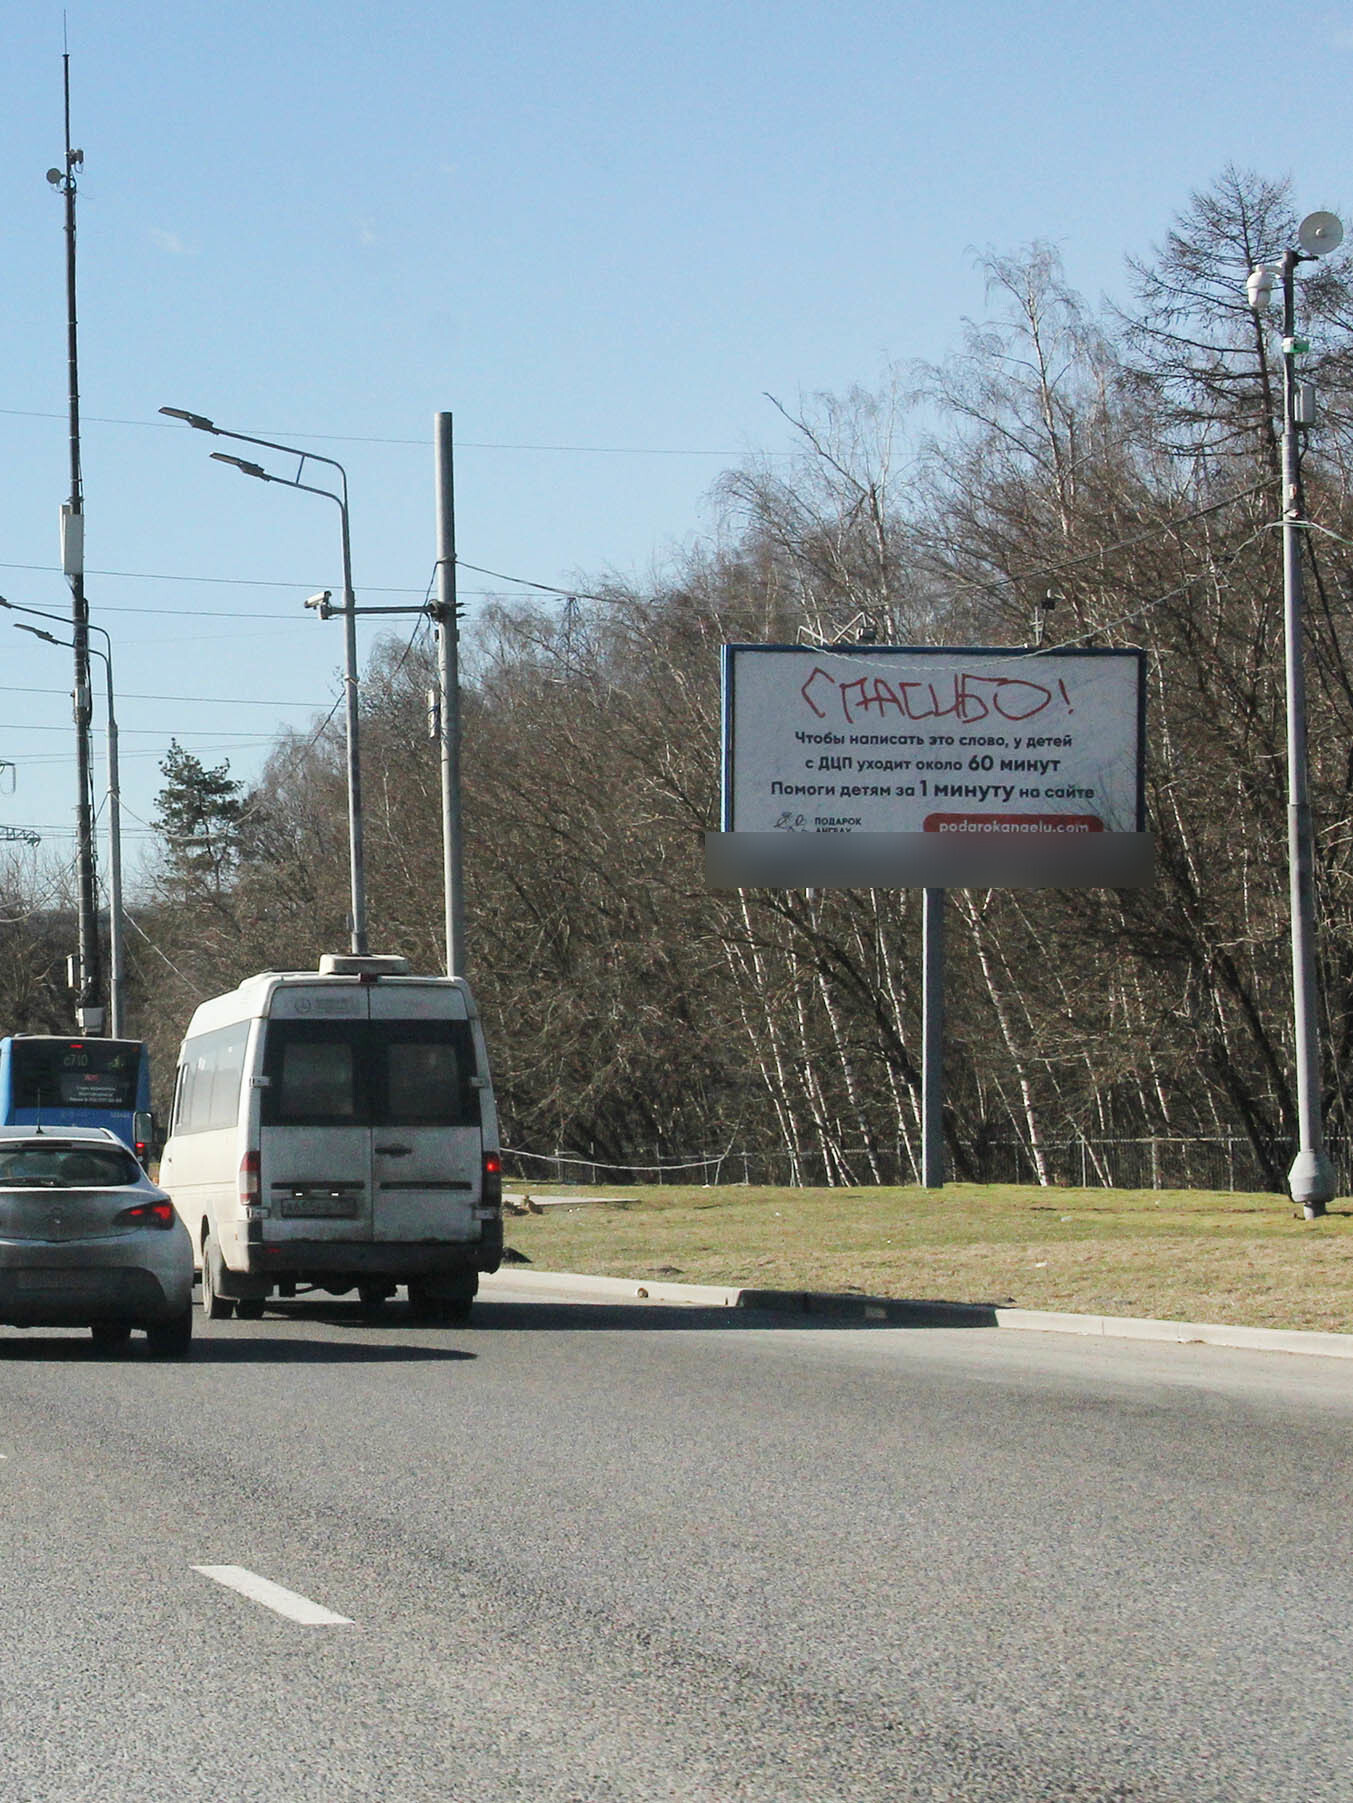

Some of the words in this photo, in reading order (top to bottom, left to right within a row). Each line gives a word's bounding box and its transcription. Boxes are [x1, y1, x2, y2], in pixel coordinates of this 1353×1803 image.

[801, 667, 1075, 724] СПАСИБО!
[794, 731, 845, 745] Чтобы
[849, 735, 925, 746] написать
[928, 735, 955, 747] это
[959, 736, 1009, 749] слово,
[1013, 736, 1022, 749] у
[1026, 734, 1073, 748] детей
[805, 759, 815, 769] с
[818, 757, 852, 771] ДЦП
[857, 760, 912, 772] уходит
[915, 760, 963, 771] около
[968, 754, 994, 771] 60
[1000, 759, 1061, 775] минут
[771, 781, 836, 795] Помоги
[839, 785, 891, 798] детям
[895, 786, 915, 797] за
[919, 780, 928, 797] 1
[934, 783, 1015, 802] минуту
[1019, 786, 1040, 798] на
[1044, 784, 1095, 799] сайте
[814, 817, 862, 826] ПОДАРОК
